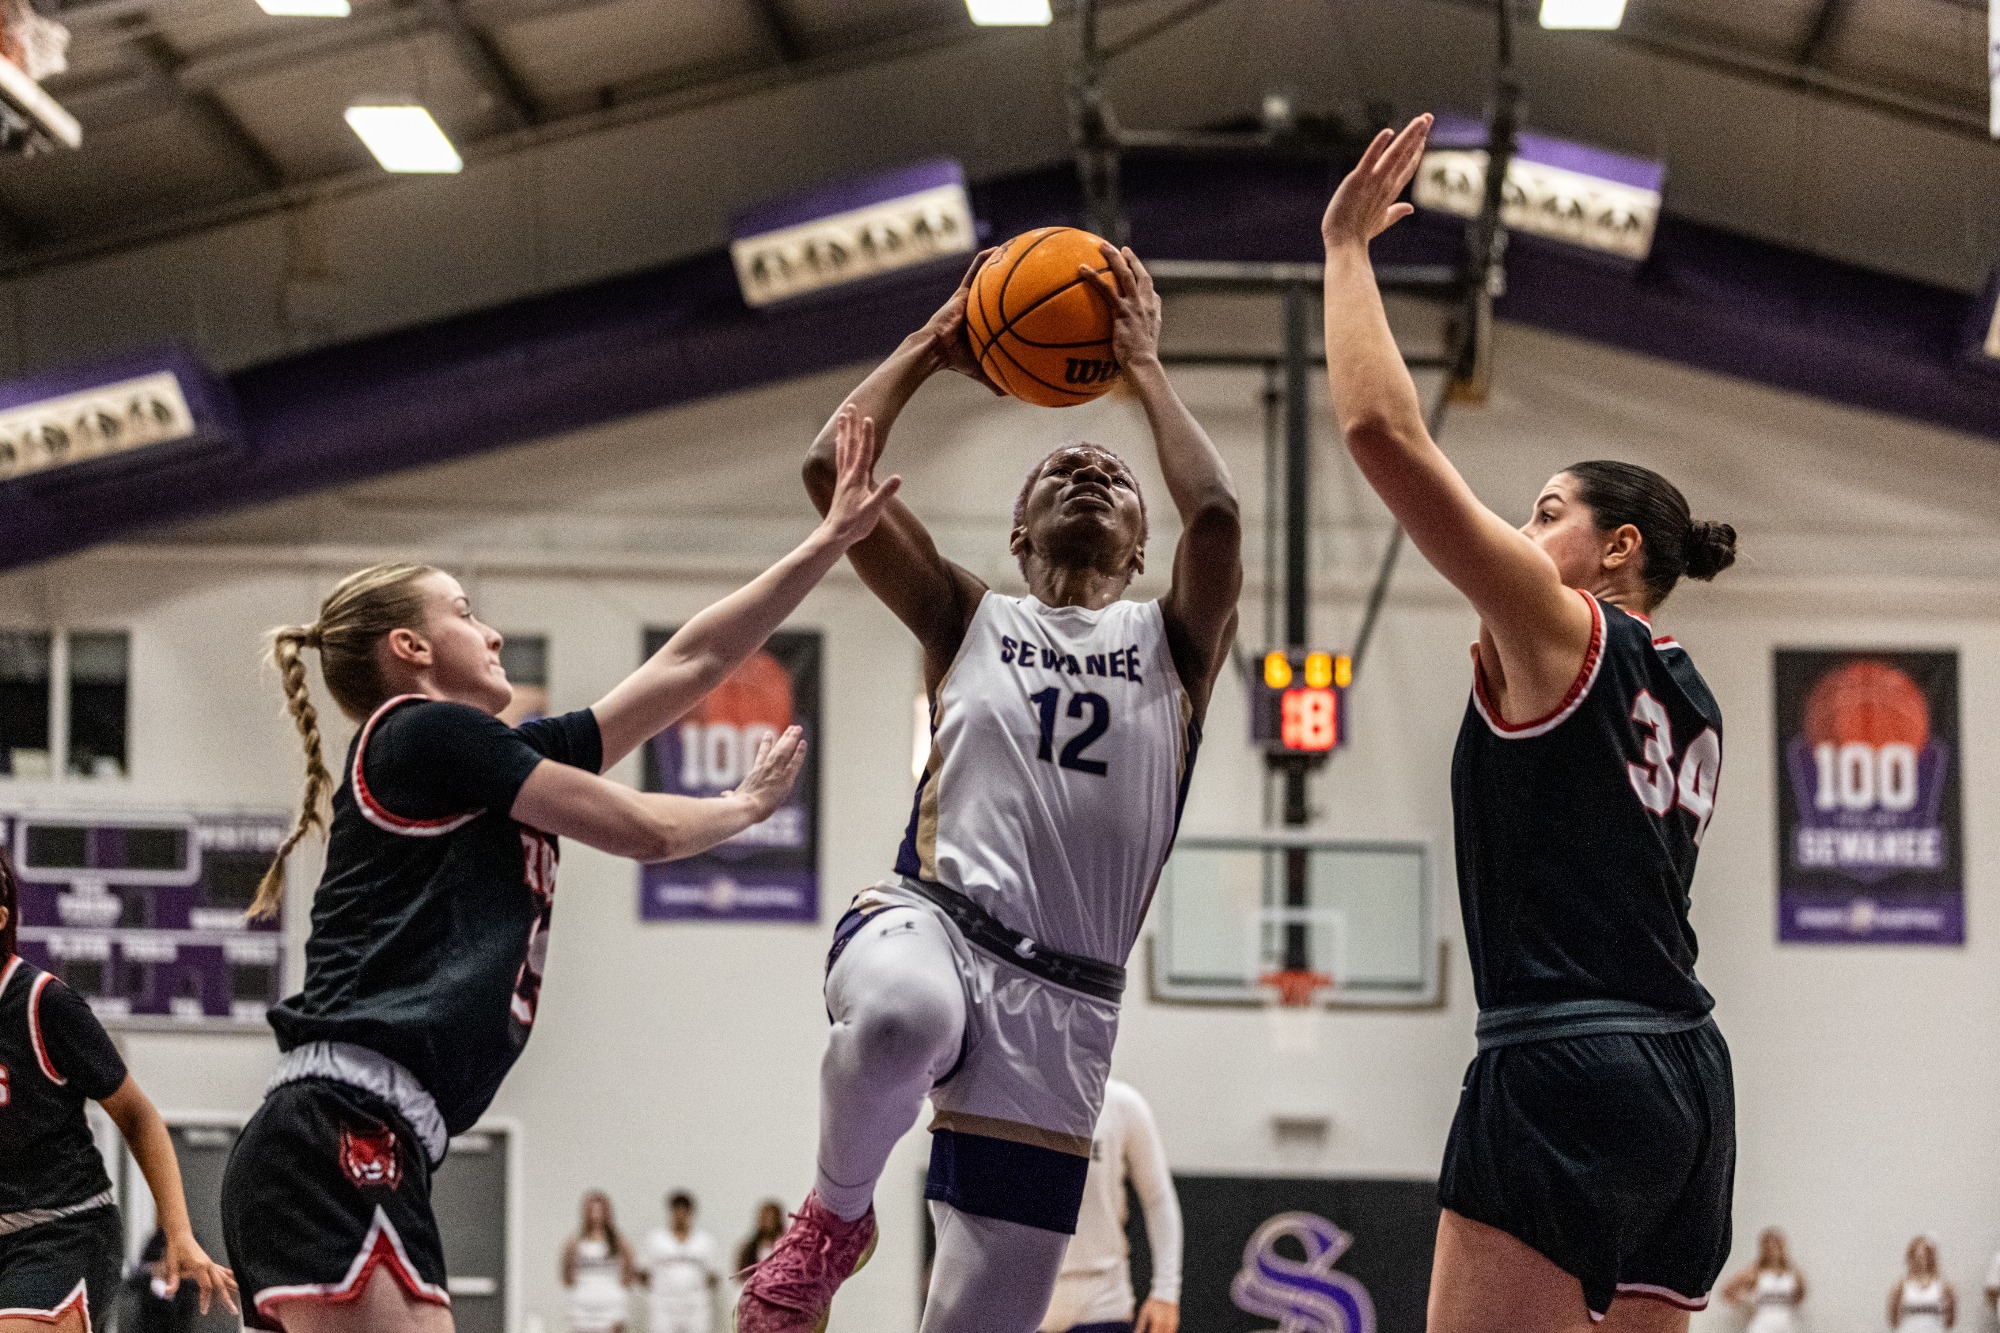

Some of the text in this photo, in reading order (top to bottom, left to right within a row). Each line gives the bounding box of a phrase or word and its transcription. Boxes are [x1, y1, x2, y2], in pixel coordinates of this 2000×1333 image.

[1001, 635, 1143, 685] SEWANEE
[1030, 686, 1110, 777] 12
[1626, 687, 1721, 850] 34
[1814, 741, 1918, 811] 100
